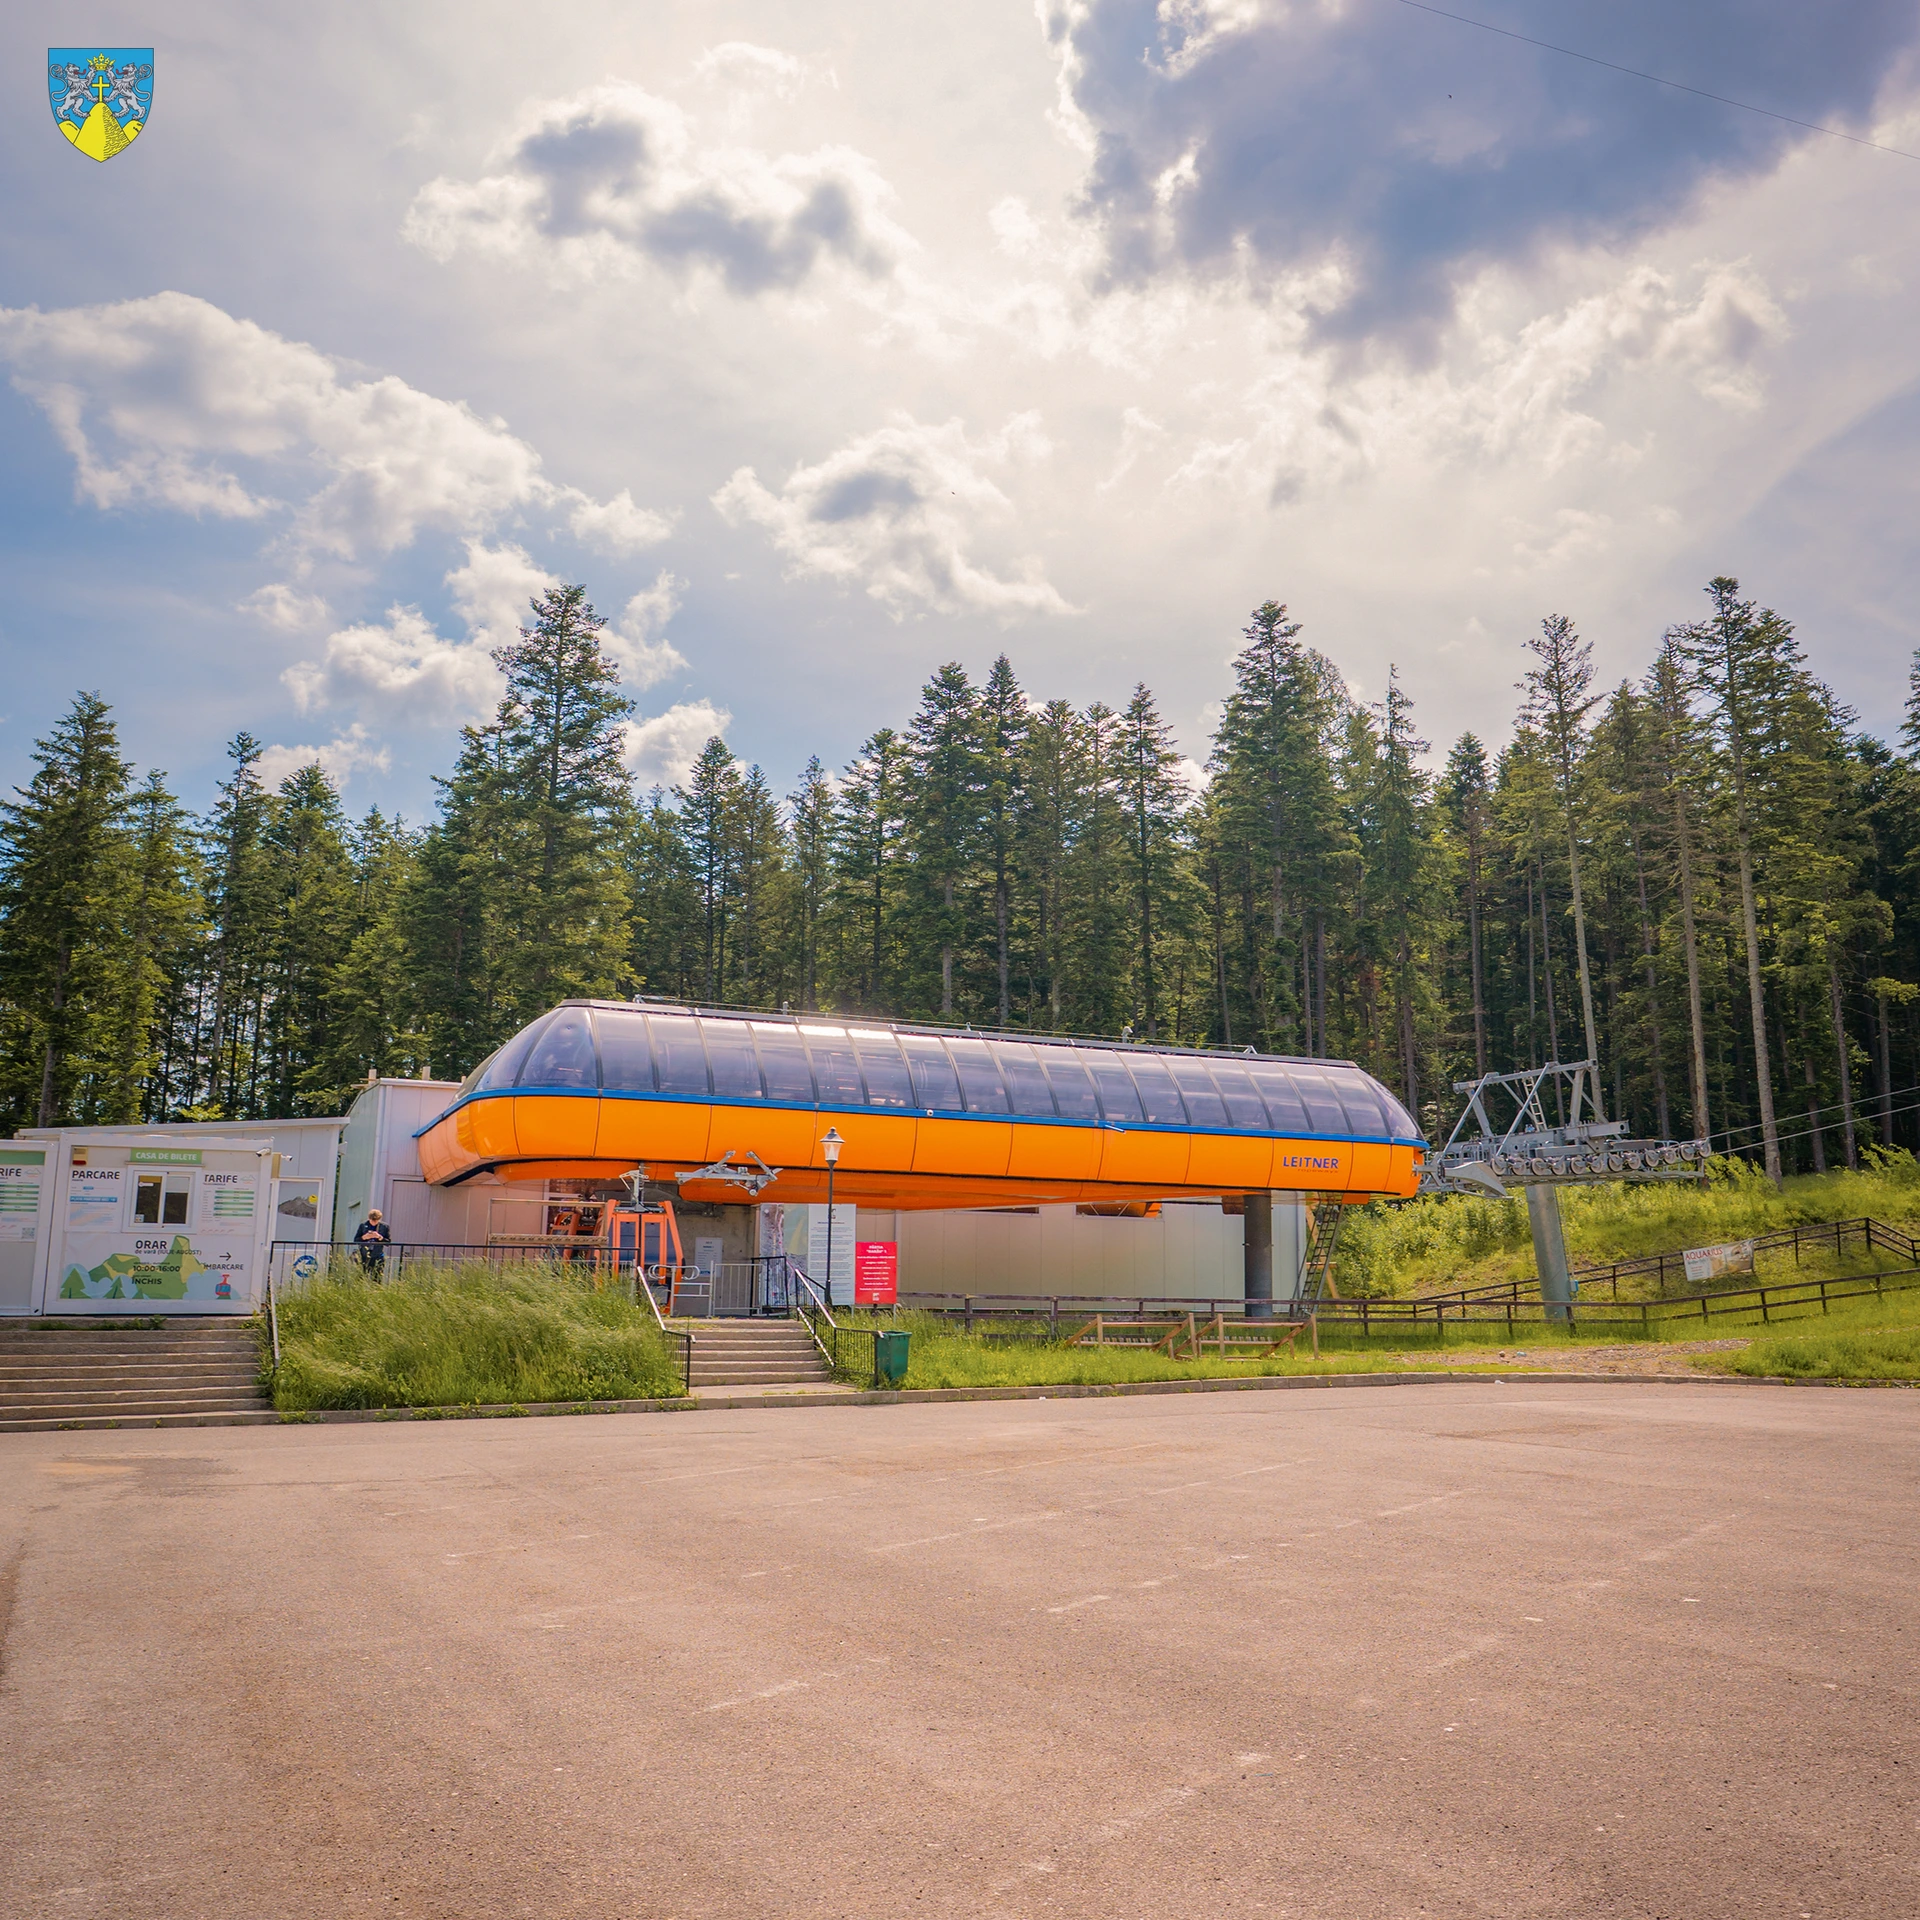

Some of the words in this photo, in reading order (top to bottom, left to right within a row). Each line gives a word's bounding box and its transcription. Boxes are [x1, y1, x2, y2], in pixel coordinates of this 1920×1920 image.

[135, 1151, 156, 1159] CASA
[158, 1152, 169, 1160] DE
[170, 1153, 197, 1161] BILETE
[1283, 1156, 1339, 1169] LEITNER
[72, 1170, 120, 1180] PARCARE
[204, 1174, 238, 1184] TARIFE
[135, 1240, 167, 1249] ORAR
[1685, 1247, 1723, 1260] AQUARIUS
